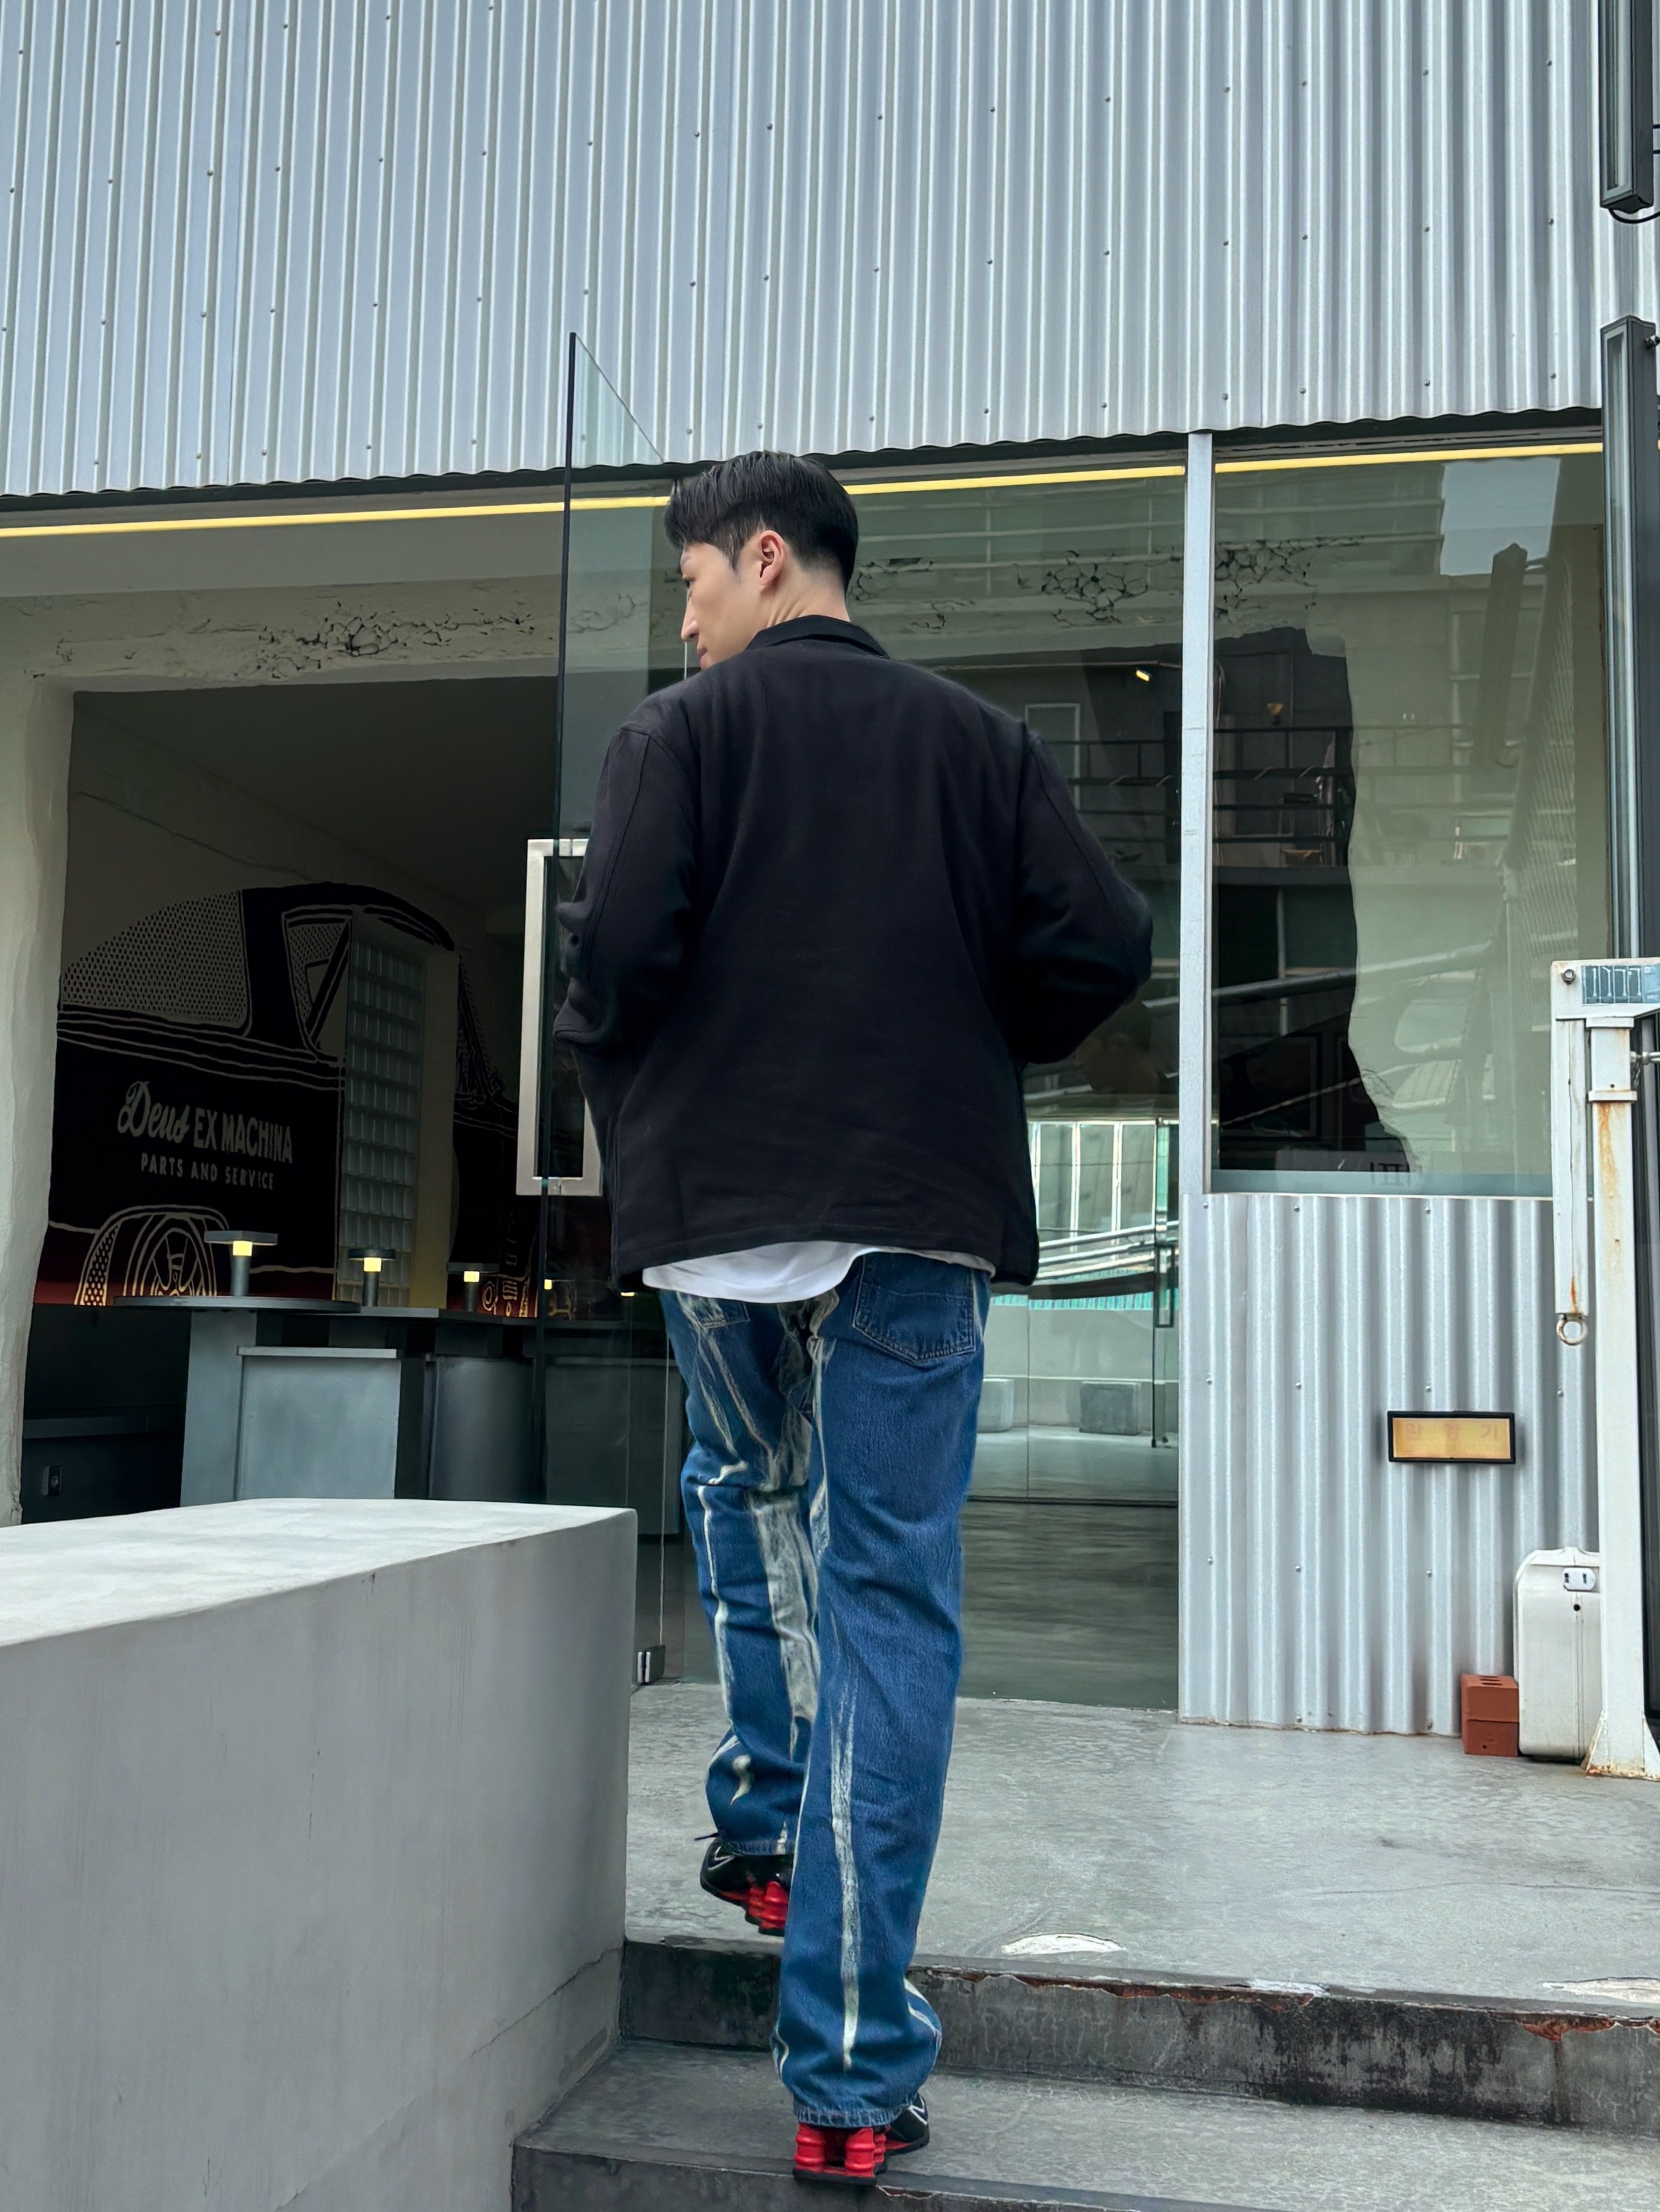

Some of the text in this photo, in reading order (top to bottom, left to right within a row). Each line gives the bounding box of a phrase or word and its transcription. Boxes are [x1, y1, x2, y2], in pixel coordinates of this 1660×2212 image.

[117, 1081, 293, 1164] Deus EX MACHINA
[141, 1152, 274, 1190] PARTS AND SERVICE
